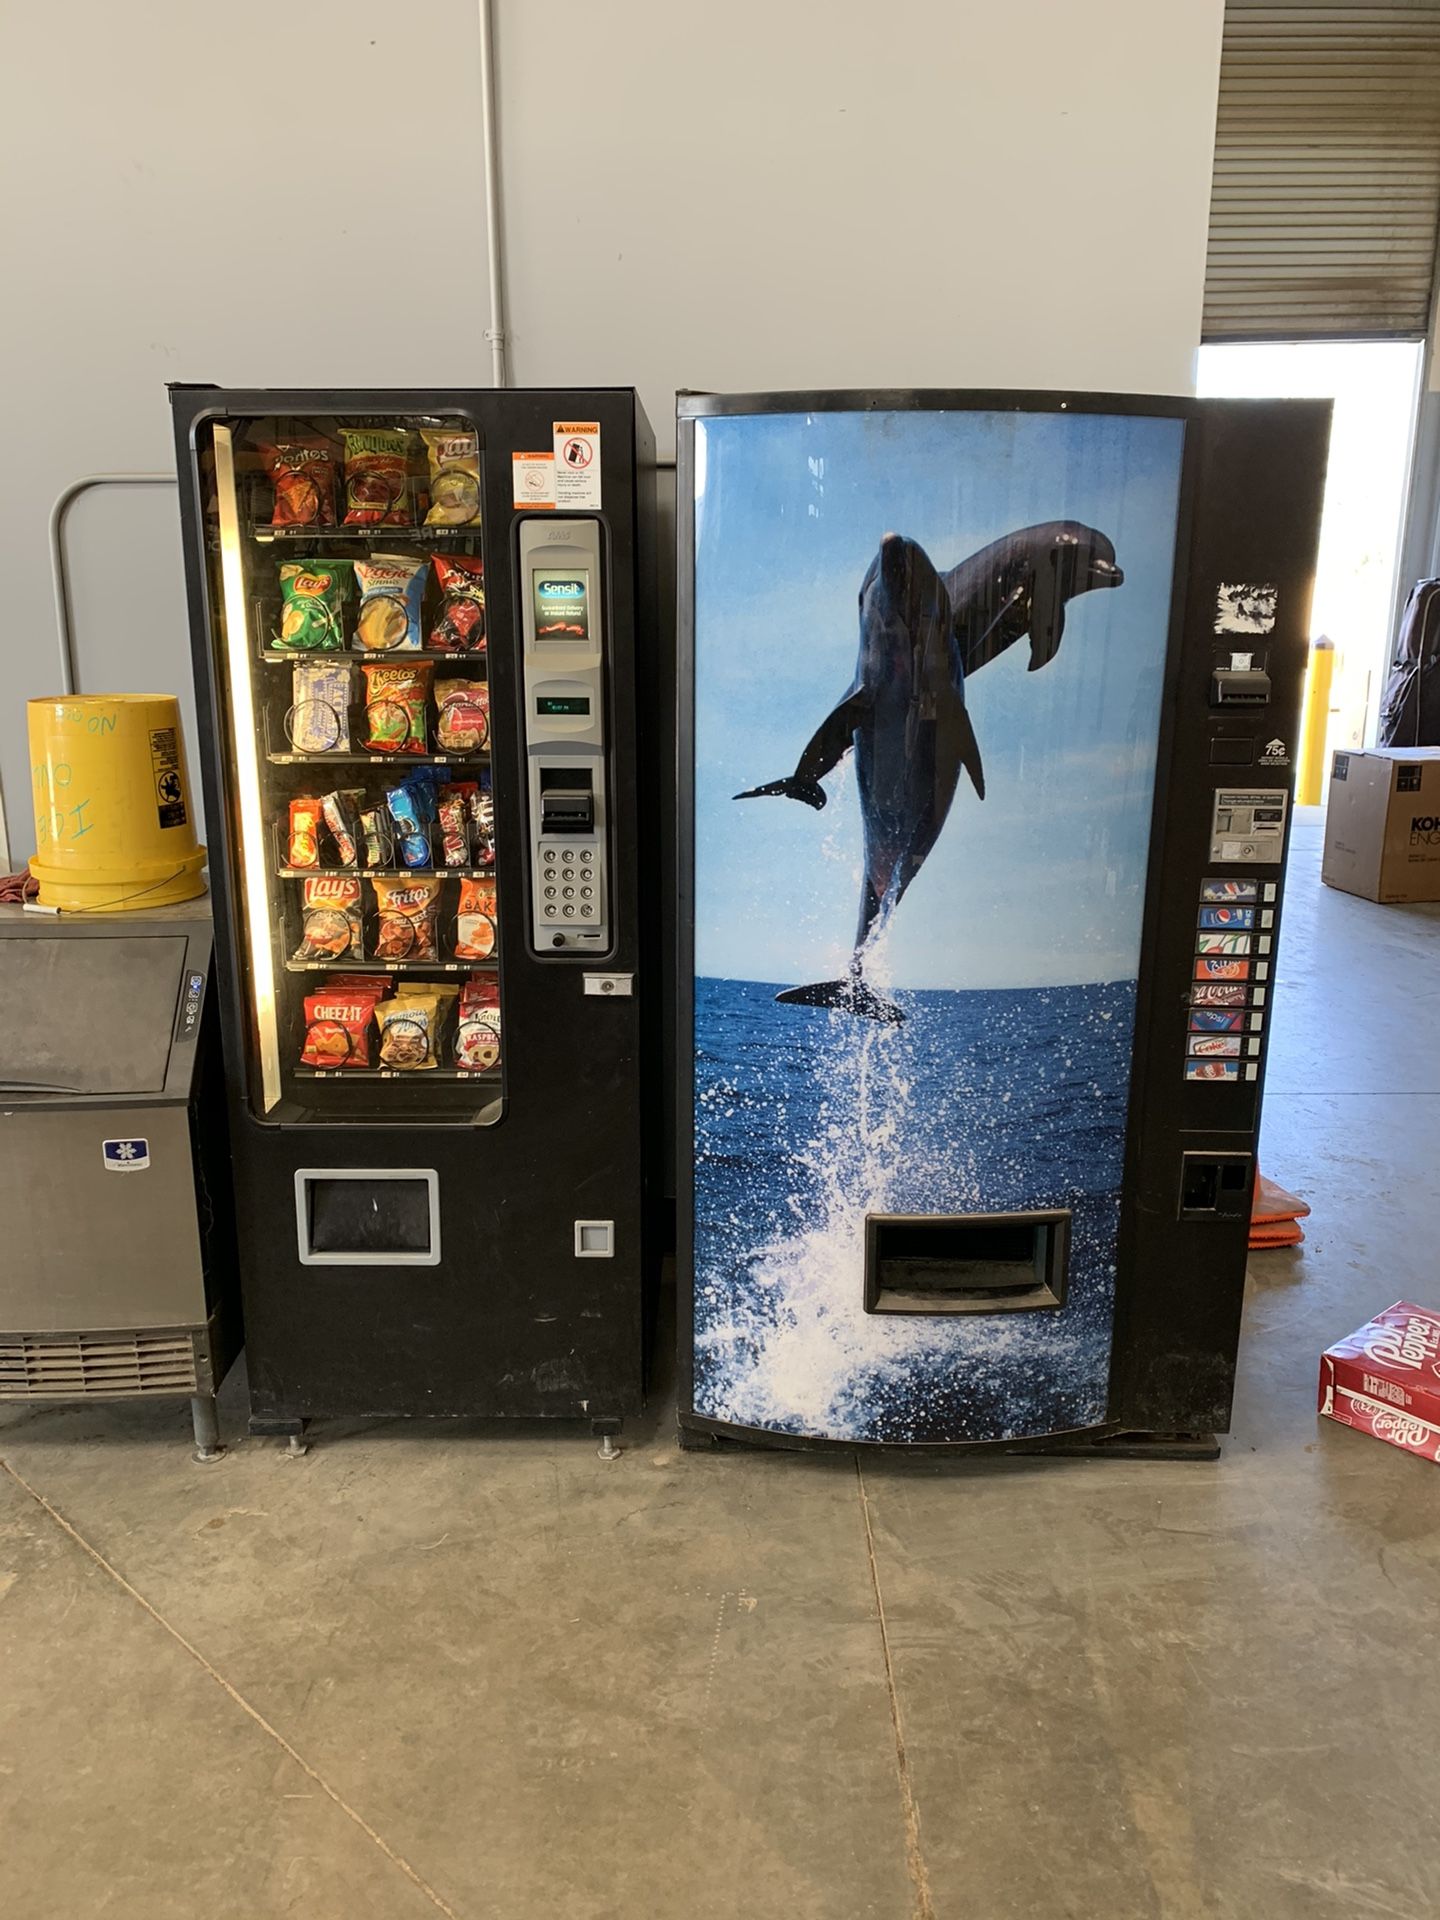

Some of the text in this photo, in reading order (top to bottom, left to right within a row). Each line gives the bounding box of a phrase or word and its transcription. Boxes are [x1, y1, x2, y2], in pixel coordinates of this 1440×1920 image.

[358, 567, 413, 579] Veggie
[298, 576, 330, 588] Lay's
[544, 583, 579, 595] Sensit
[368, 668, 416, 696] Cheetos
[1265, 744, 1286, 756] 75¢
[308, 876, 356, 899] Lay's
[386, 887, 430, 904] Fritos
[313, 1006, 362, 1021] CHEEZ-IT
[1367, 1323, 1405, 1347] Dr
[1377, 1416, 1424, 1446] Pepper
[1387, 1429, 1407, 1445] Dr
